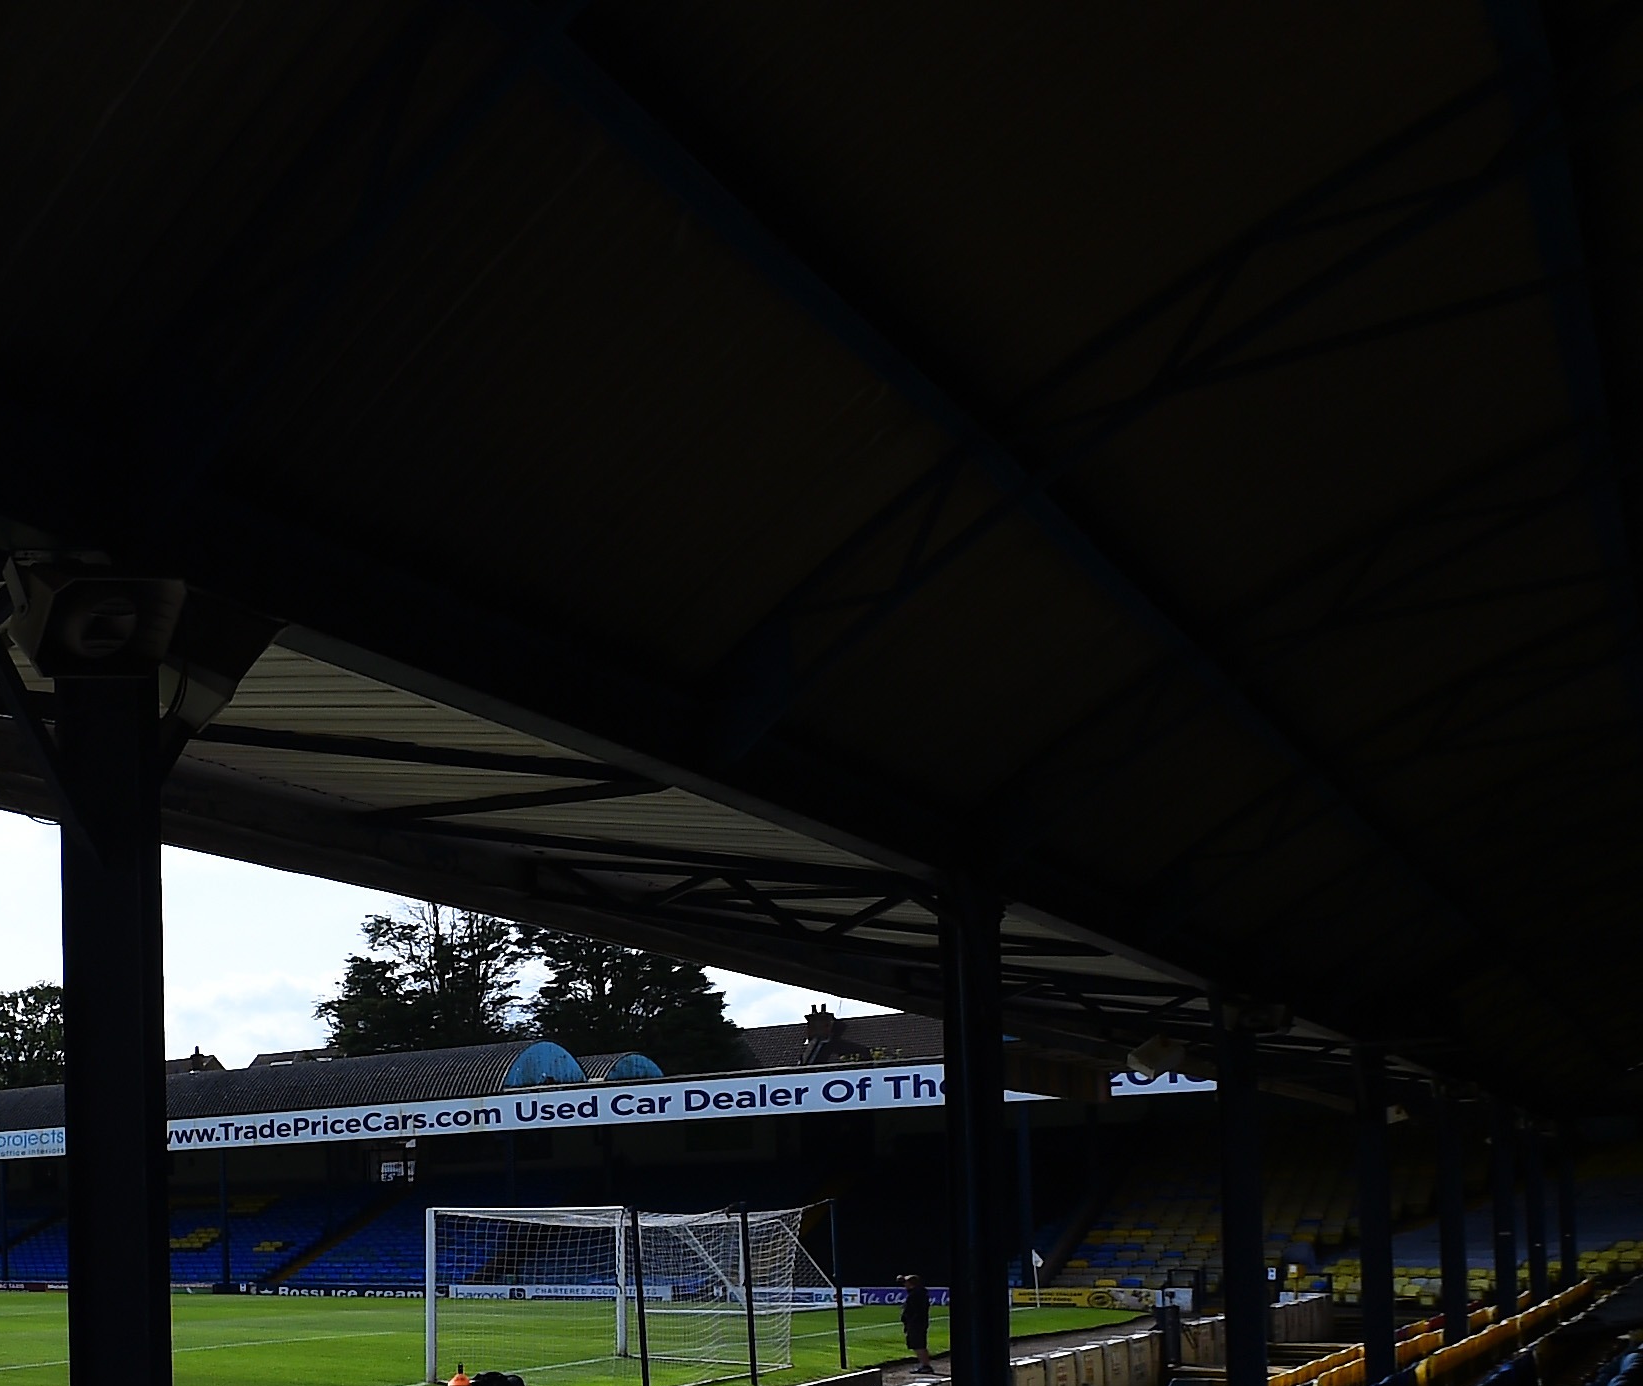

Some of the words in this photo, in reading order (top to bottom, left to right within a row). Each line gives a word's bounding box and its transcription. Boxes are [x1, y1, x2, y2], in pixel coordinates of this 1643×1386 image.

[514, 1094, 599, 1122] Used
[610, 1091, 672, 1117] Car
[684, 1084, 809, 1114] Dealer
[822, 1076, 873, 1104] Of
[884, 1073, 946, 1101] Th
[364, 1289, 424, 1298] cream
[535, 1287, 589, 1295] CHARTERED
[861, 1292, 881, 1305] The
